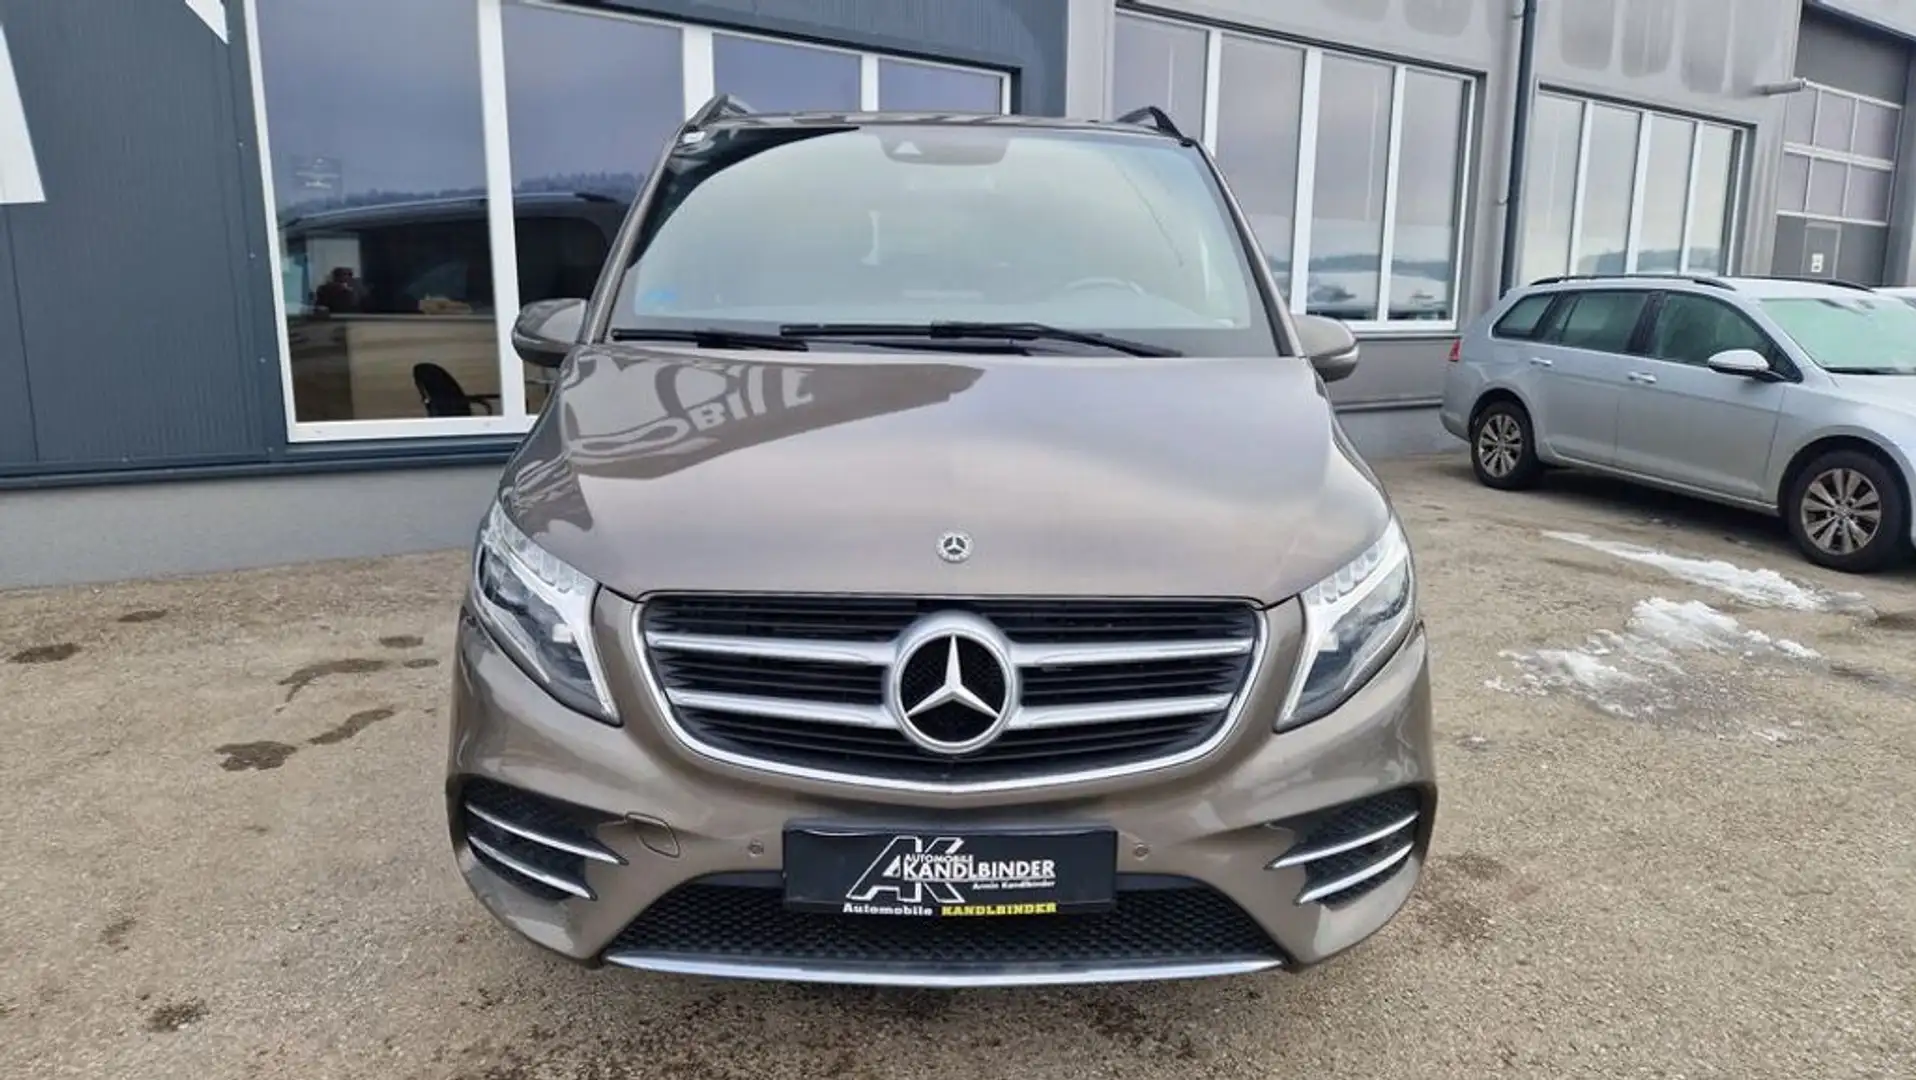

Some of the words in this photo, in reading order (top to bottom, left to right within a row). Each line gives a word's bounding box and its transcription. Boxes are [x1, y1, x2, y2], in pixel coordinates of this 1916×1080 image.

[903, 859, 1056, 880] KANDLBINDER
[843, 902, 933, 916] Automobile
[942, 902, 1057, 917] KANDLBINDER
